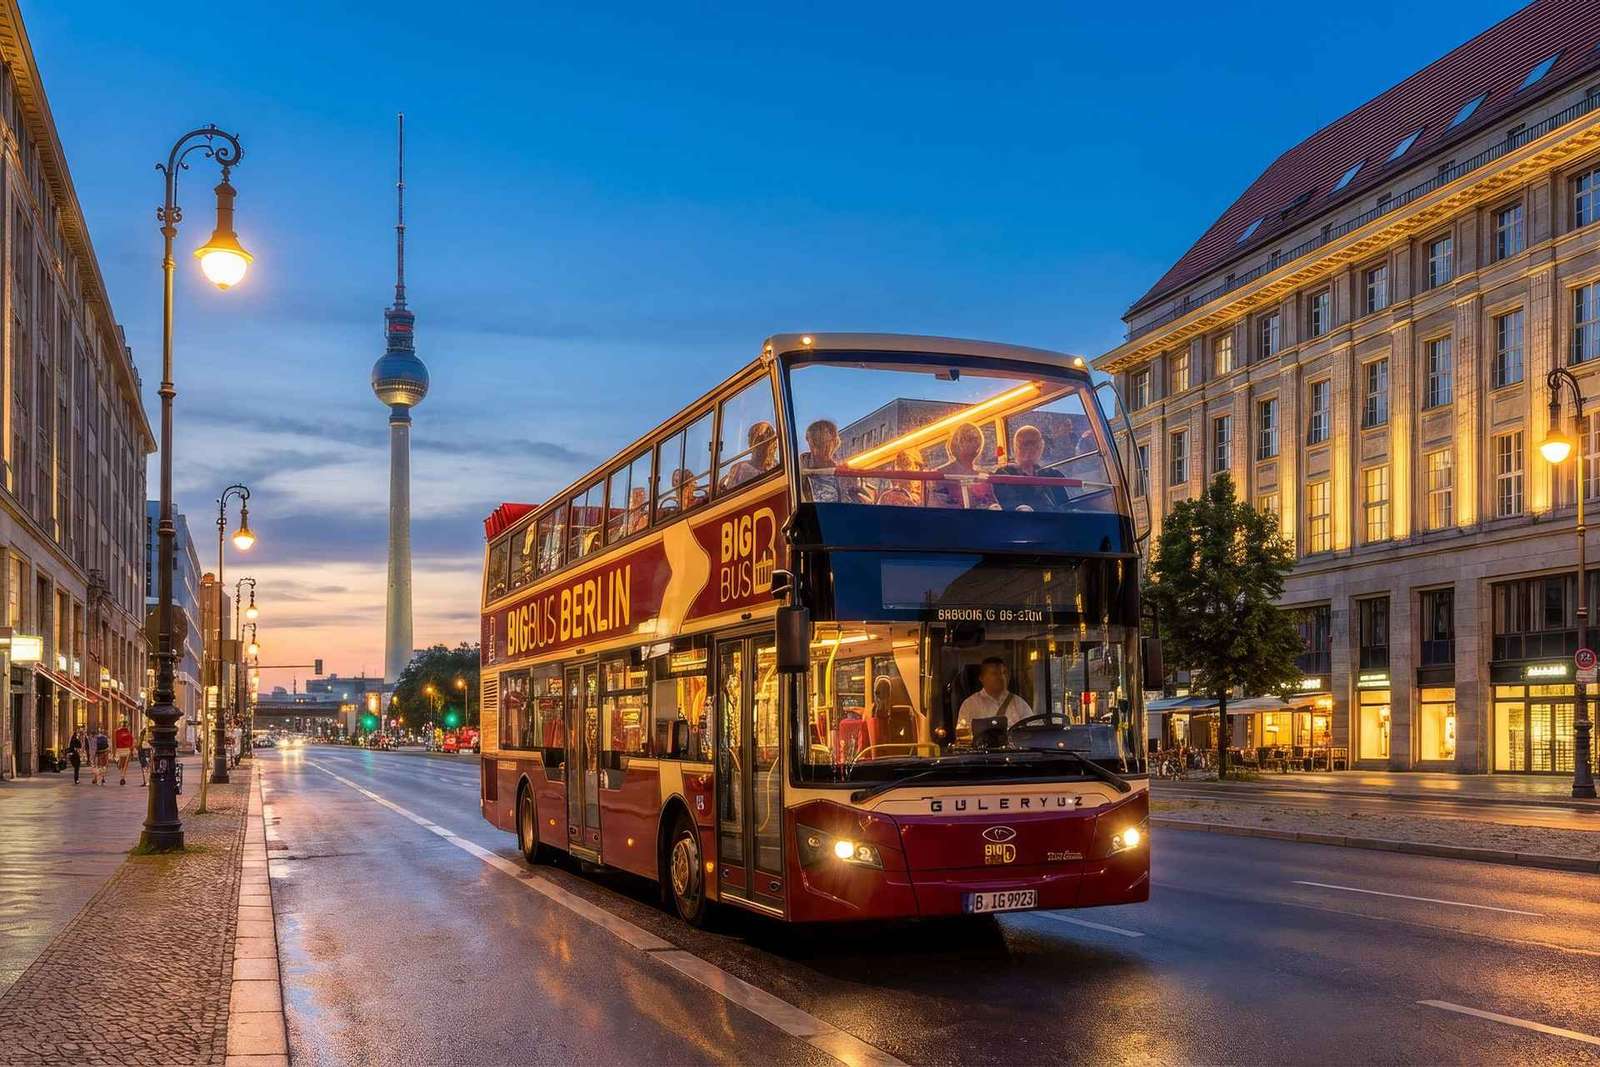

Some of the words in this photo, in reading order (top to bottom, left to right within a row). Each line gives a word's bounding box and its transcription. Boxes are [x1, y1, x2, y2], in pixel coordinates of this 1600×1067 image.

[721, 514, 752, 563] BIG
[560, 564, 631, 642] BERLIN
[720, 560, 752, 602] BUS
